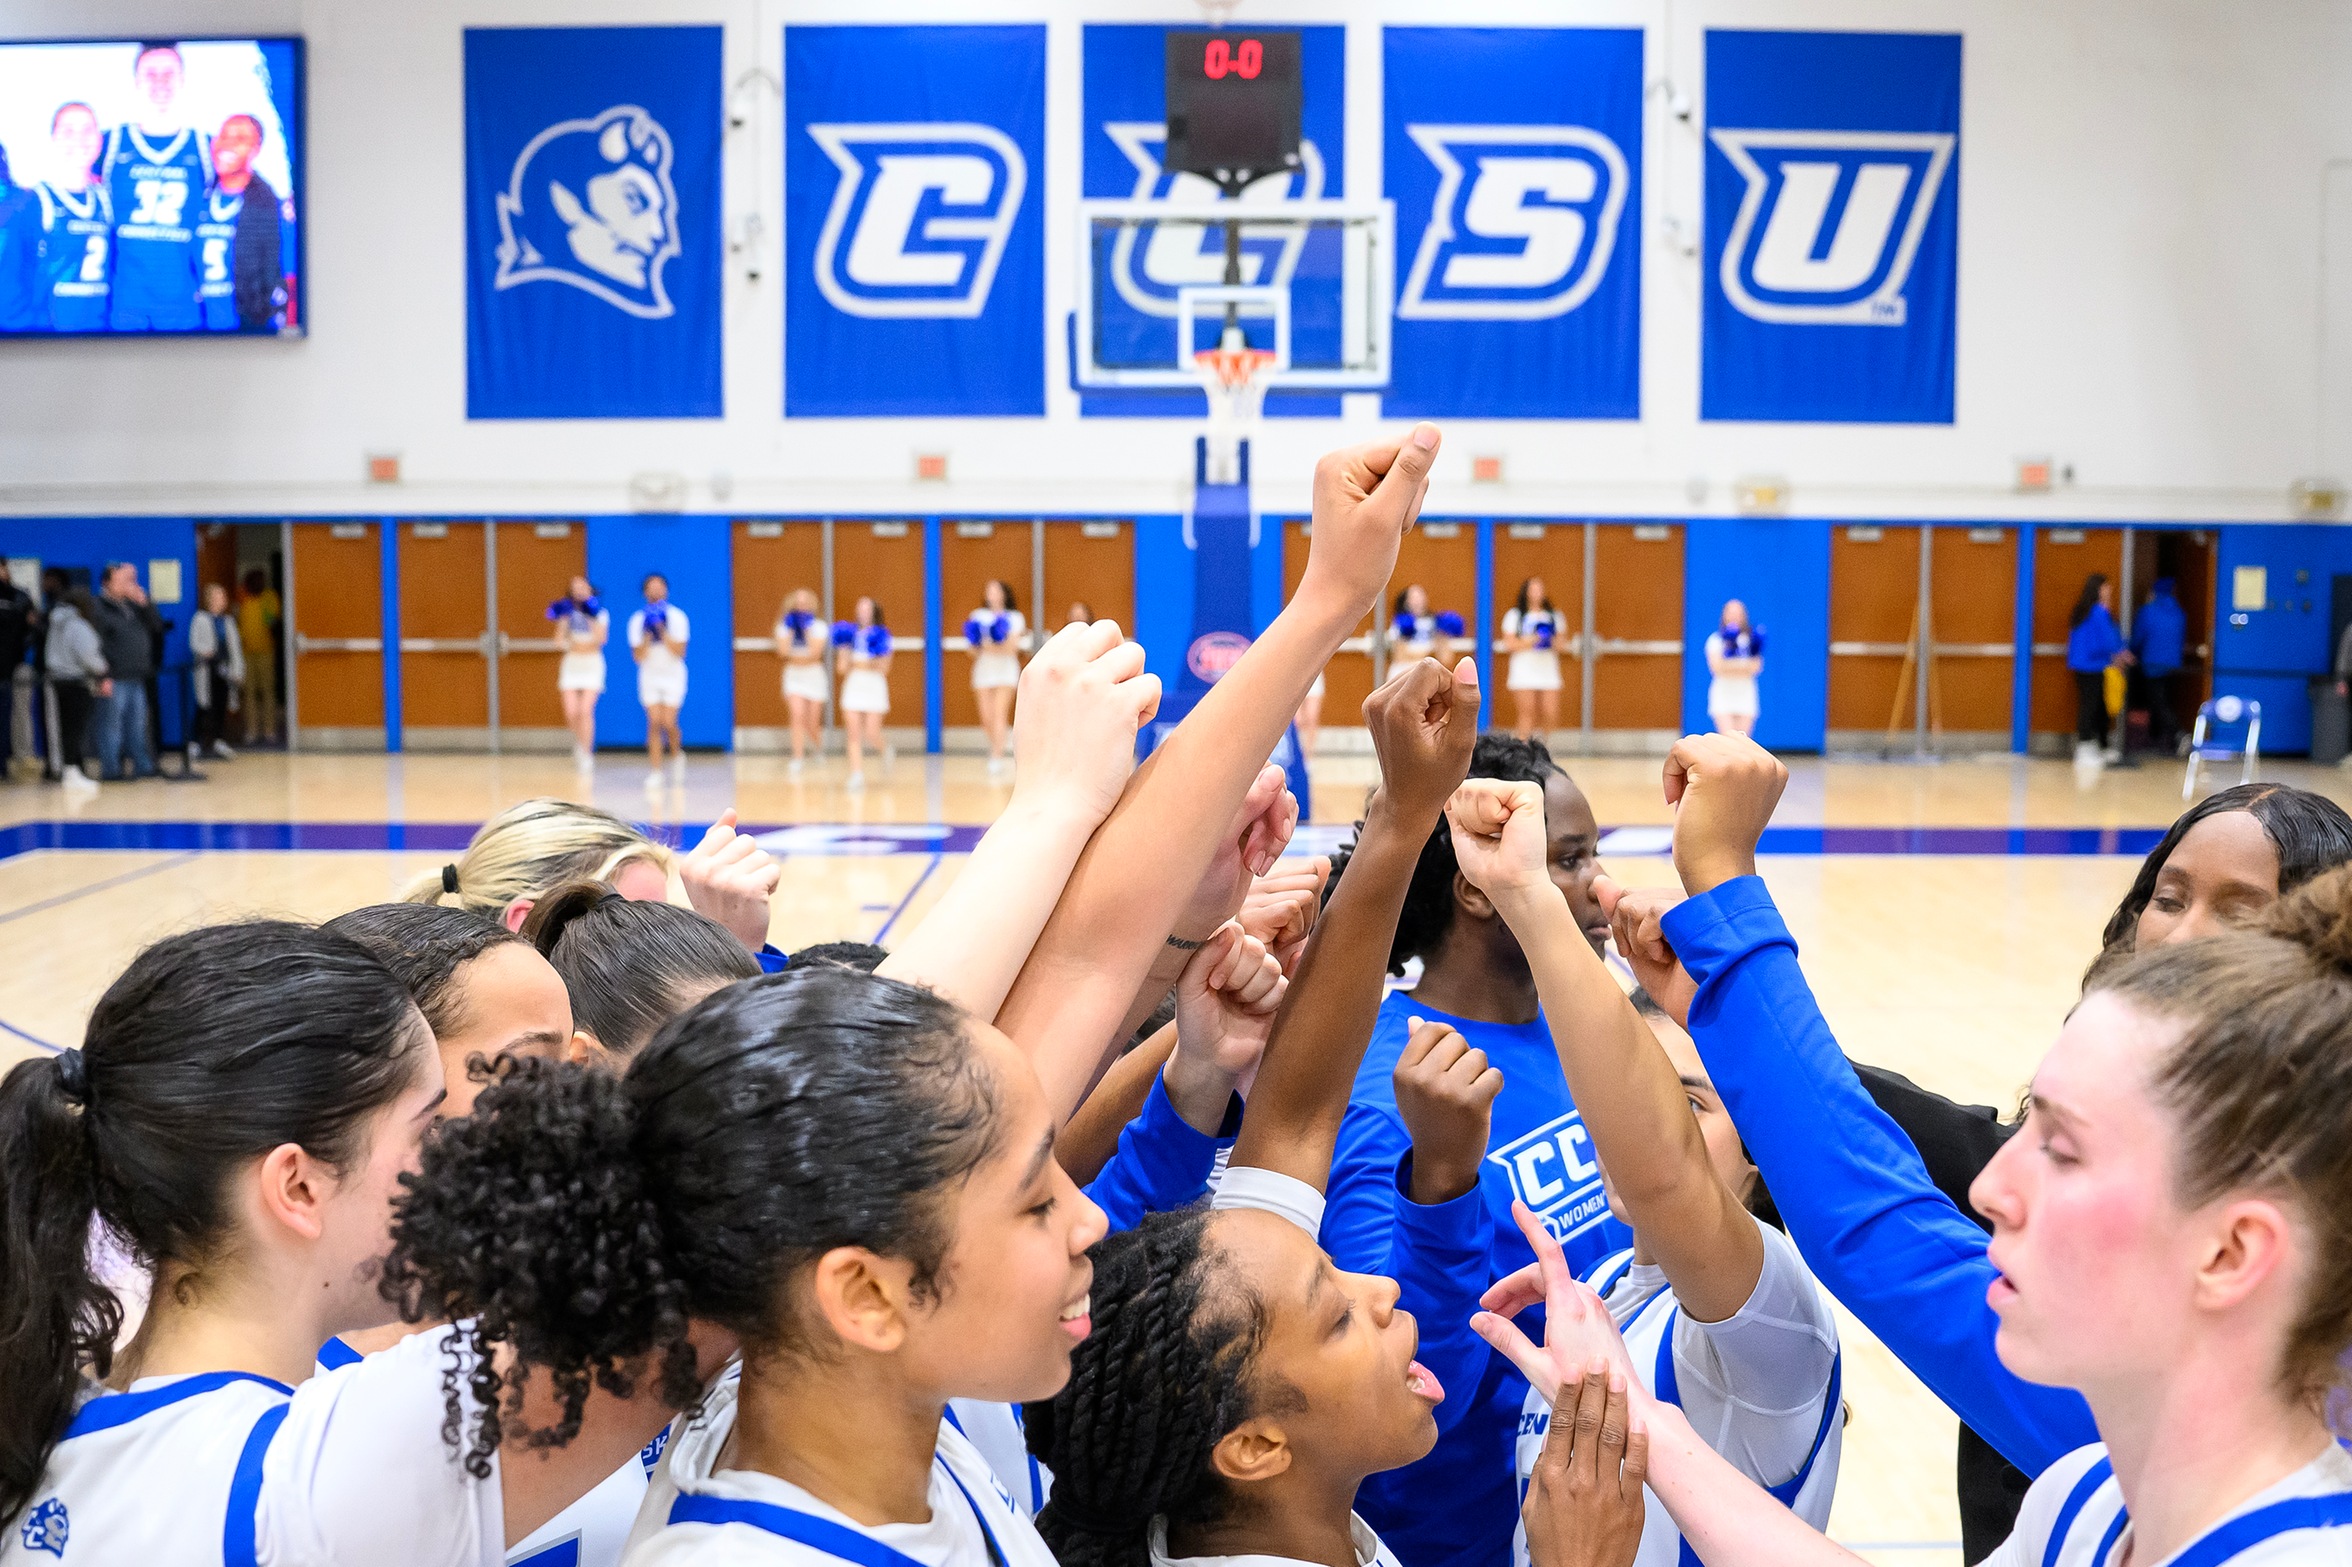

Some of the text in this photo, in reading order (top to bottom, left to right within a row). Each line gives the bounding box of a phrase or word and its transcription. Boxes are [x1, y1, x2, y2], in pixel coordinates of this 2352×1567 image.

[1203, 39, 1263, 80] 0-0
[1512, 1123, 1598, 1206] CC
[1558, 1190, 1607, 1230] WOMEN'
